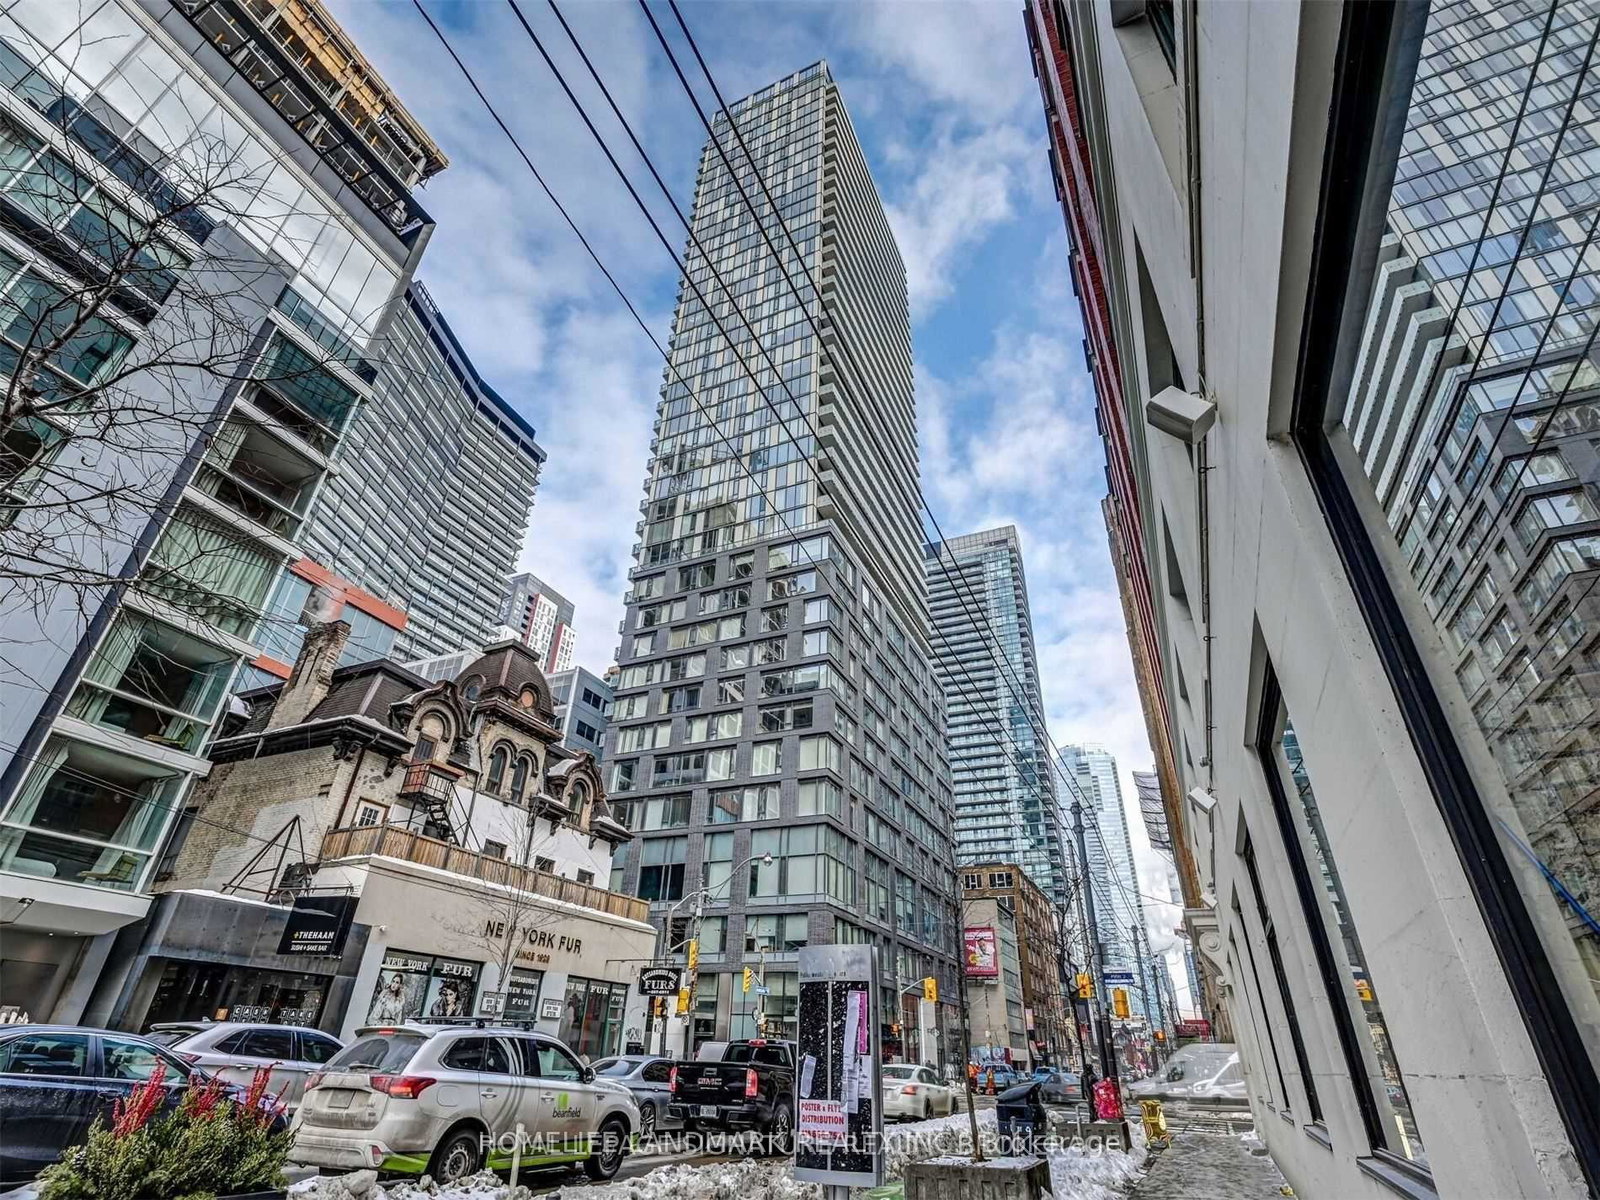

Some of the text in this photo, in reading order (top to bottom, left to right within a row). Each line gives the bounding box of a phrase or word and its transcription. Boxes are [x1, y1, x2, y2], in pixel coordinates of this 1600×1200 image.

[522, 927, 556, 949] YORK
[558, 936, 582, 954] FUR
[384, 956, 429, 971] NEW YORK
[440, 962, 472, 977] FUR
[590, 985, 609, 995] FUR
[643, 980, 675, 990] FURS
[697, 1077, 722, 1086] GMC
[801, 1102, 821, 1112] POSTER
[801, 1114, 845, 1124] DISTRIBUTION
